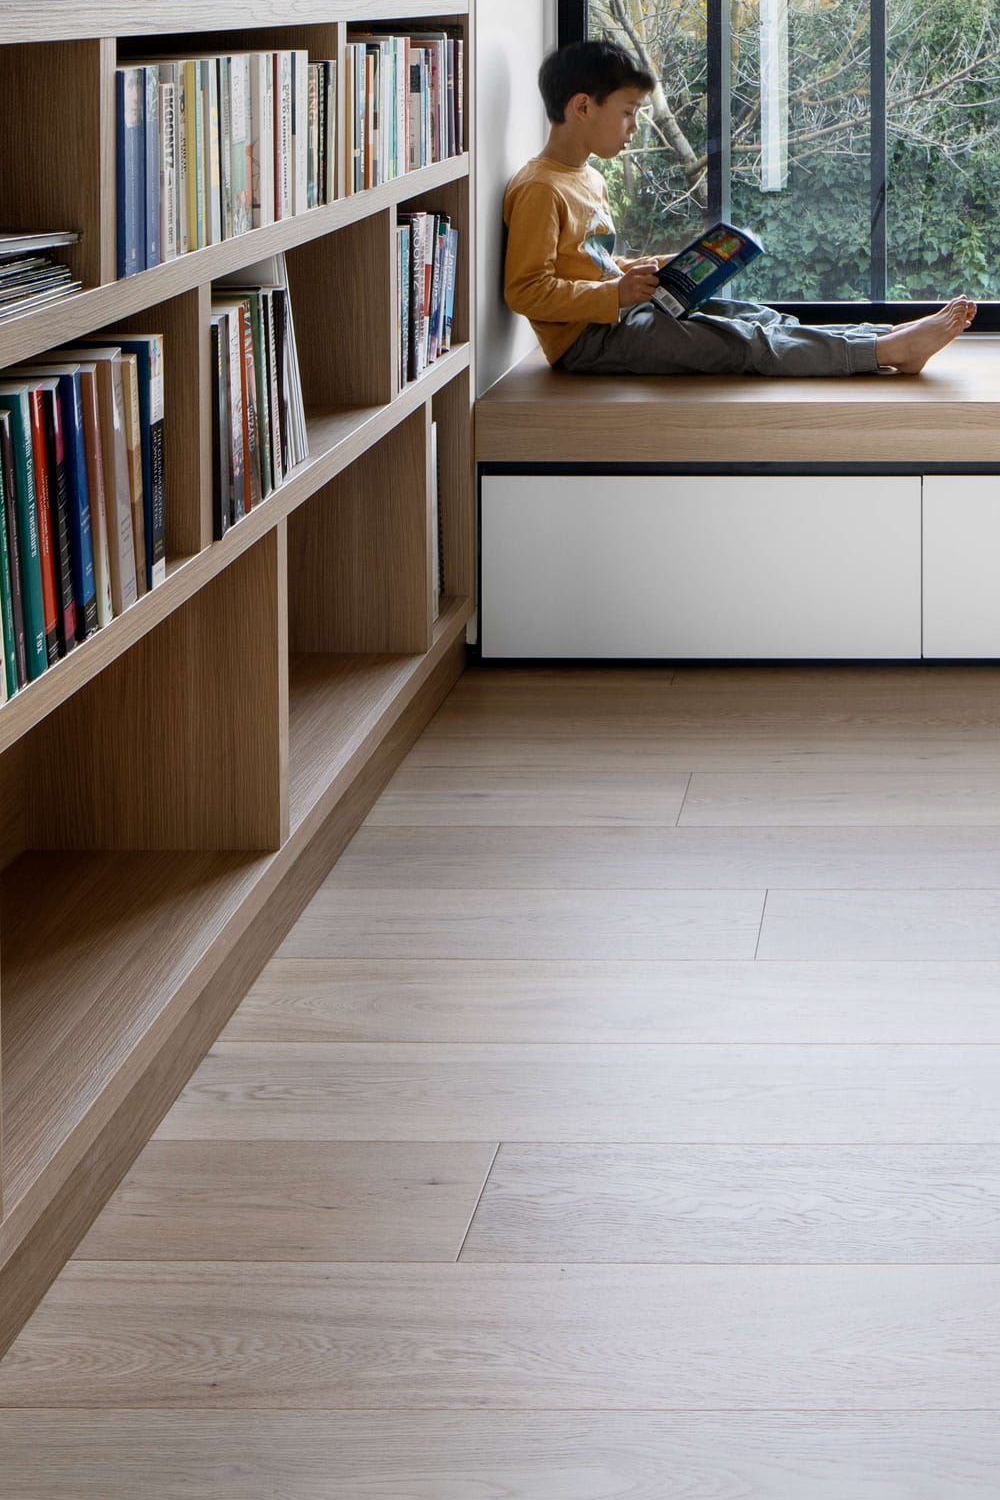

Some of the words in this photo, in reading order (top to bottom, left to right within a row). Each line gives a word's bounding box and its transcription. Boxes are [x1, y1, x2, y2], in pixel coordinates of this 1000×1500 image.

[164, 97, 174, 168] KOONTZ
[447, 250, 455, 292] Japan
[246, 405, 256, 453] WIZARD
[25, 458, 34, 501] Criminal
[29, 503, 38, 557] Procedure
[36, 631, 44, 655] Fox
